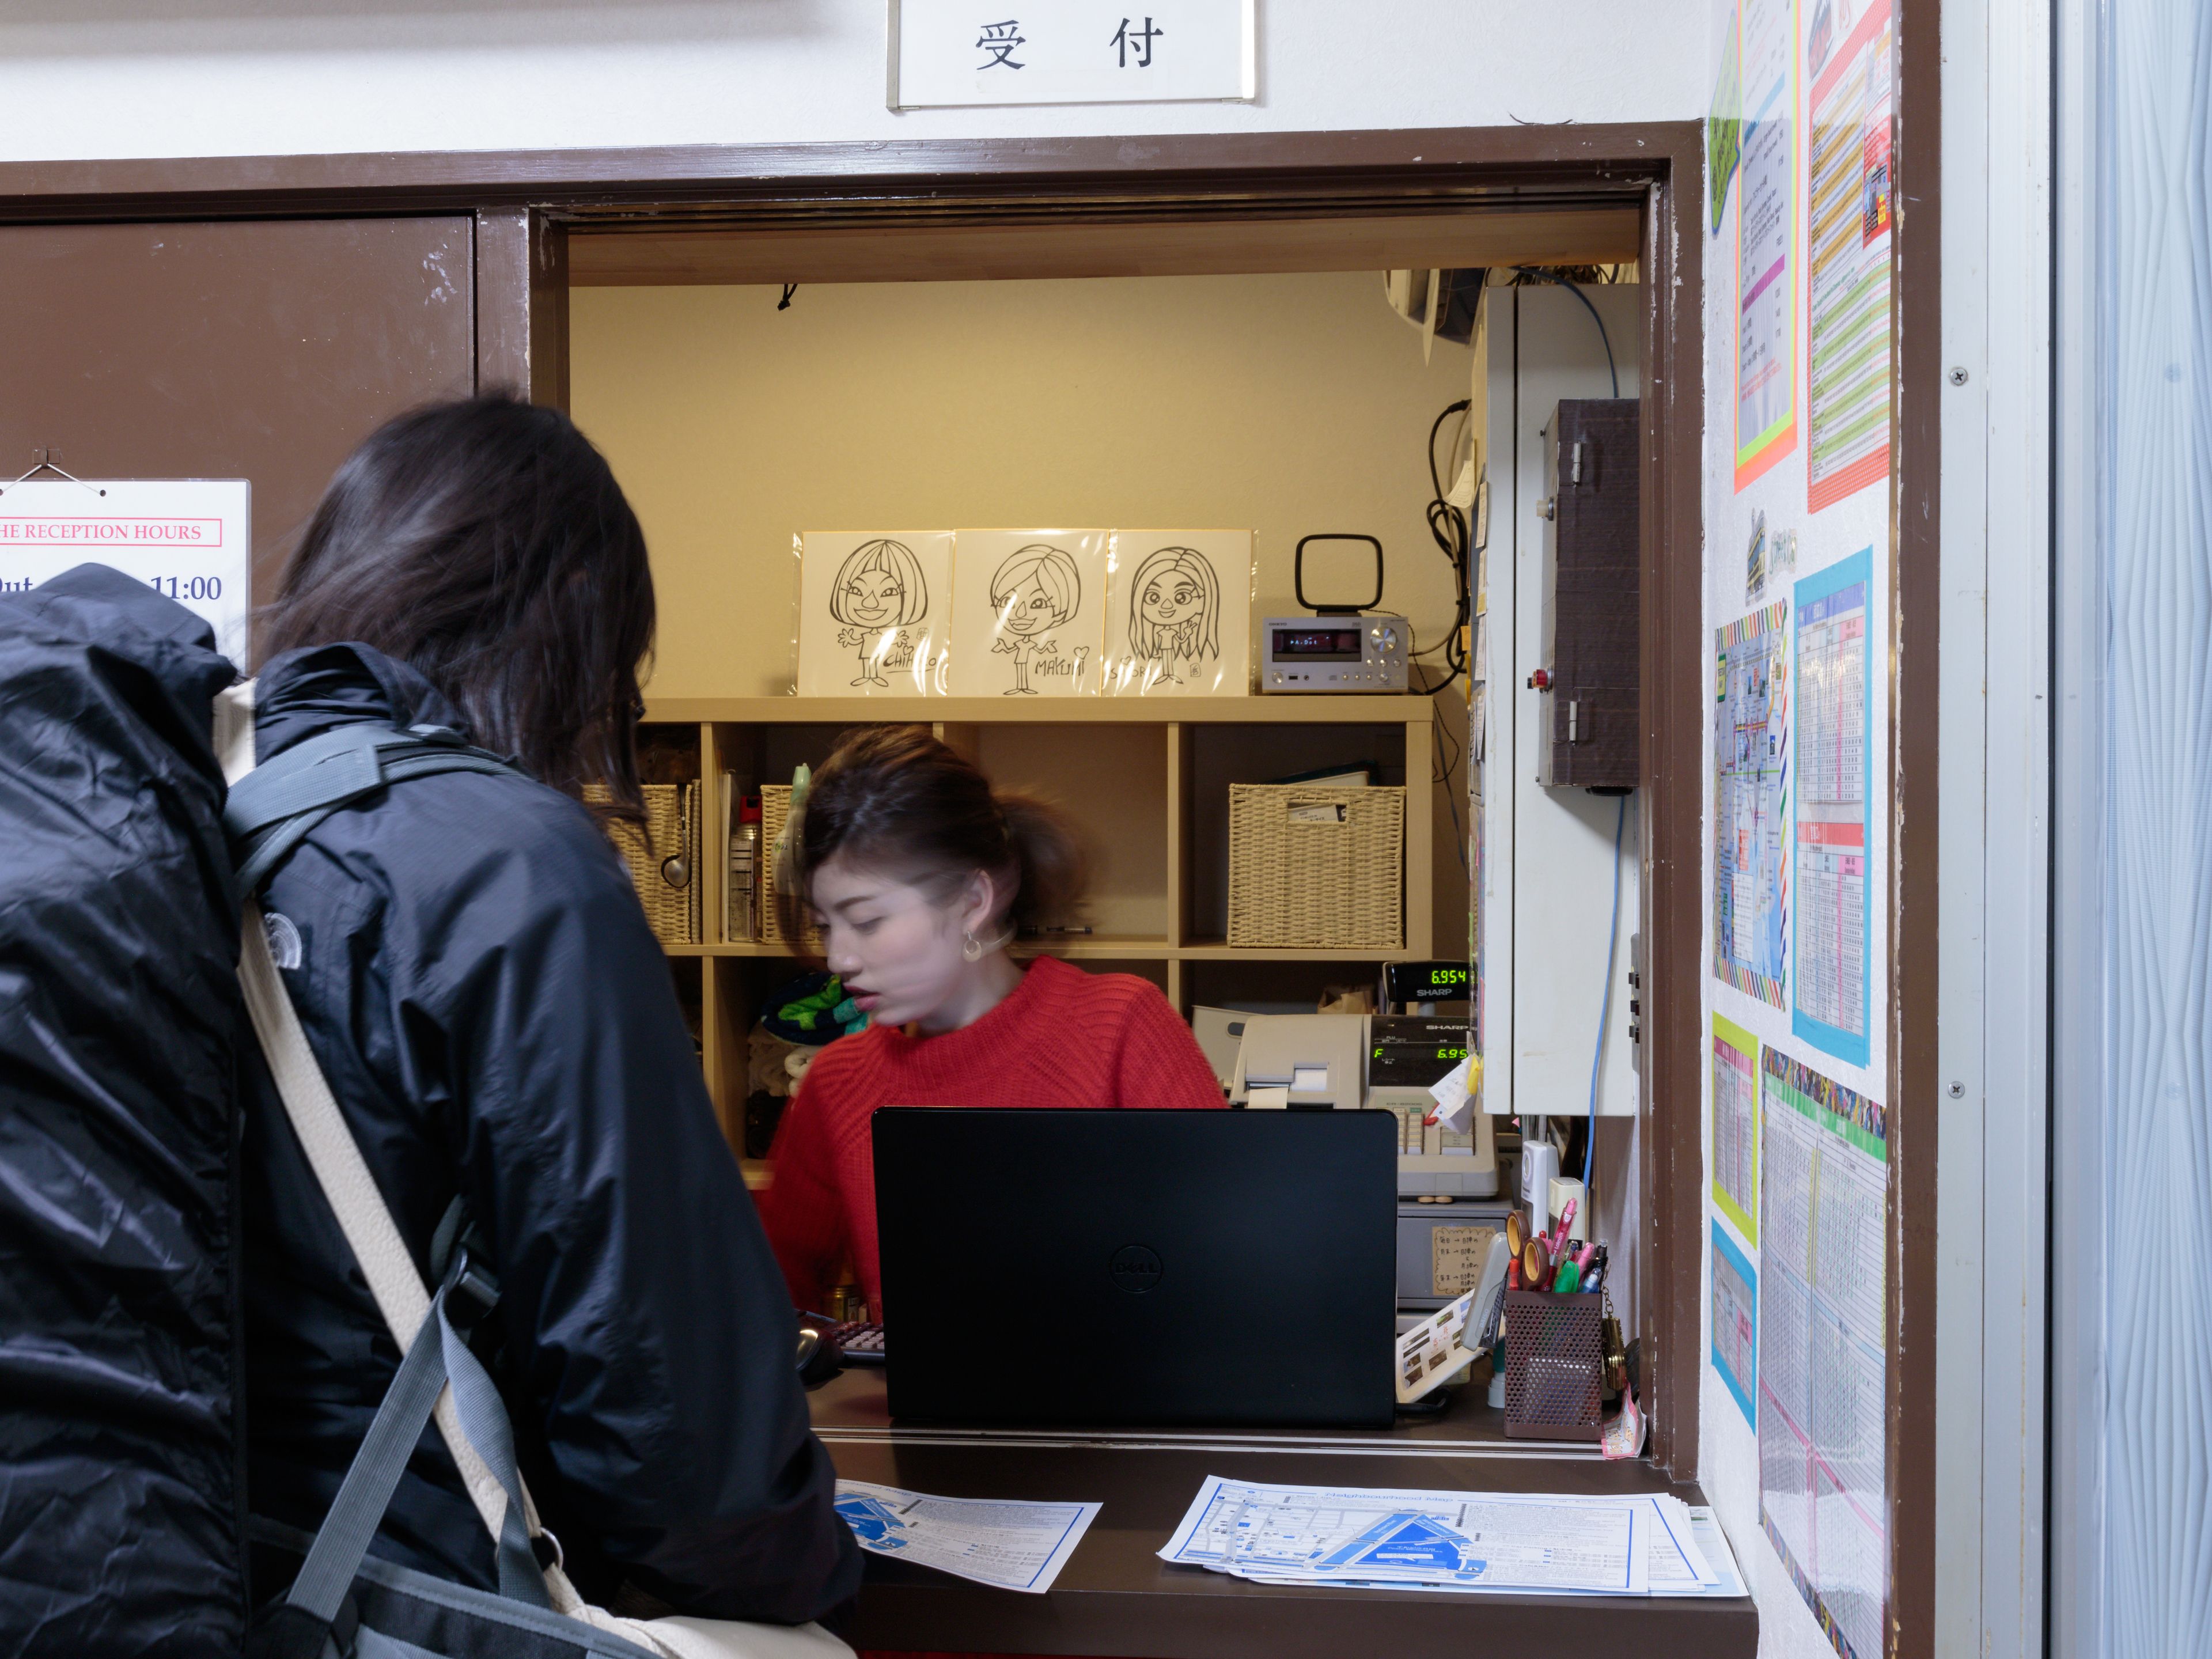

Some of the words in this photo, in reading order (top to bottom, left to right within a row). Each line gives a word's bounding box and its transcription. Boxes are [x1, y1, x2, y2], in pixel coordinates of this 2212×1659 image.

[975, 17, 1164, 70] 受付
[0, 524, 20, 539] HE
[24, 524, 129, 540] RECEPTION
[134, 525, 201, 540] HOURS
[151, 576, 222, 600] 11:00
[882, 651, 937, 668] CHIHO
[1416, 988, 1452, 997] SHARP
[1374, 1048, 1384, 1058] F
[1324, 1492, 1422, 1501] Neighbourhood
